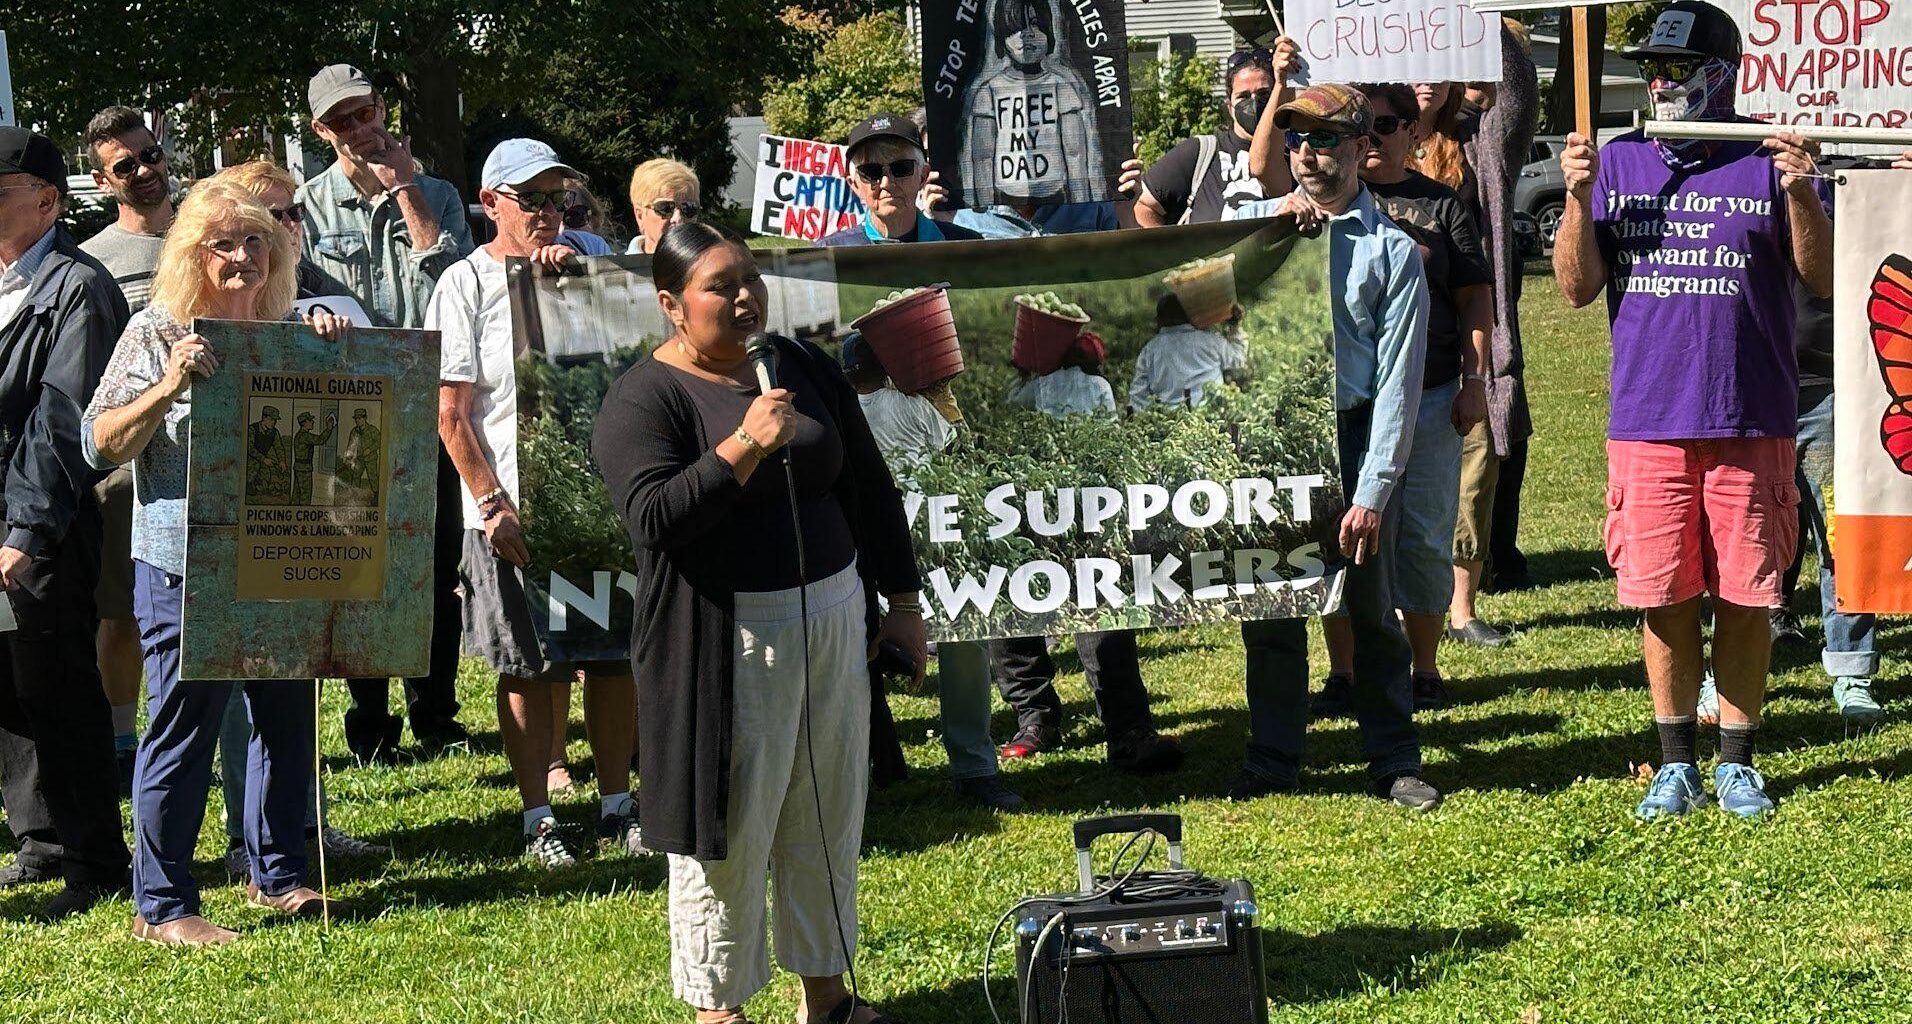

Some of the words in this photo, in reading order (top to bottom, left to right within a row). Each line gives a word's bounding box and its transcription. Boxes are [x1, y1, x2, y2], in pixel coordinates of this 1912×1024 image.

[1306, 4, 1486, 61] CRUSHED
[1656, 20, 1682, 38] CE
[1748, 0, 1891, 47] STOP
[1070, 0, 1108, 49] LIES
[1092, 55, 1121, 108] APART
[935, 38, 966, 99] STOP
[1741, 46, 1912, 95] DNAPPING
[997, 93, 1056, 130] FREE
[1796, 90, 1839, 107] OUR
[1010, 129, 1040, 152] MY
[1000, 153, 1050, 180] DAD
[1619, 192, 1678, 212] want
[1682, 191, 1722, 213] for
[1723, 196, 1772, 218] you
[1617, 248, 1642, 267] ou
[1646, 246, 1708, 268] want
[1712, 245, 1752, 269] for
[251, 375, 323, 394] NATIONAL
[327, 380, 383, 396] GUARDS
[246, 509, 293, 522] PICKING
[984, 474, 1324, 541] SUPPORT
[246, 525, 299, 537] WINDOWS
[300, 525, 308, 536] &
[253, 546, 372, 560] DEPORTATION
[283, 567, 341, 581] SUCKS
[548, 569, 638, 632] N
